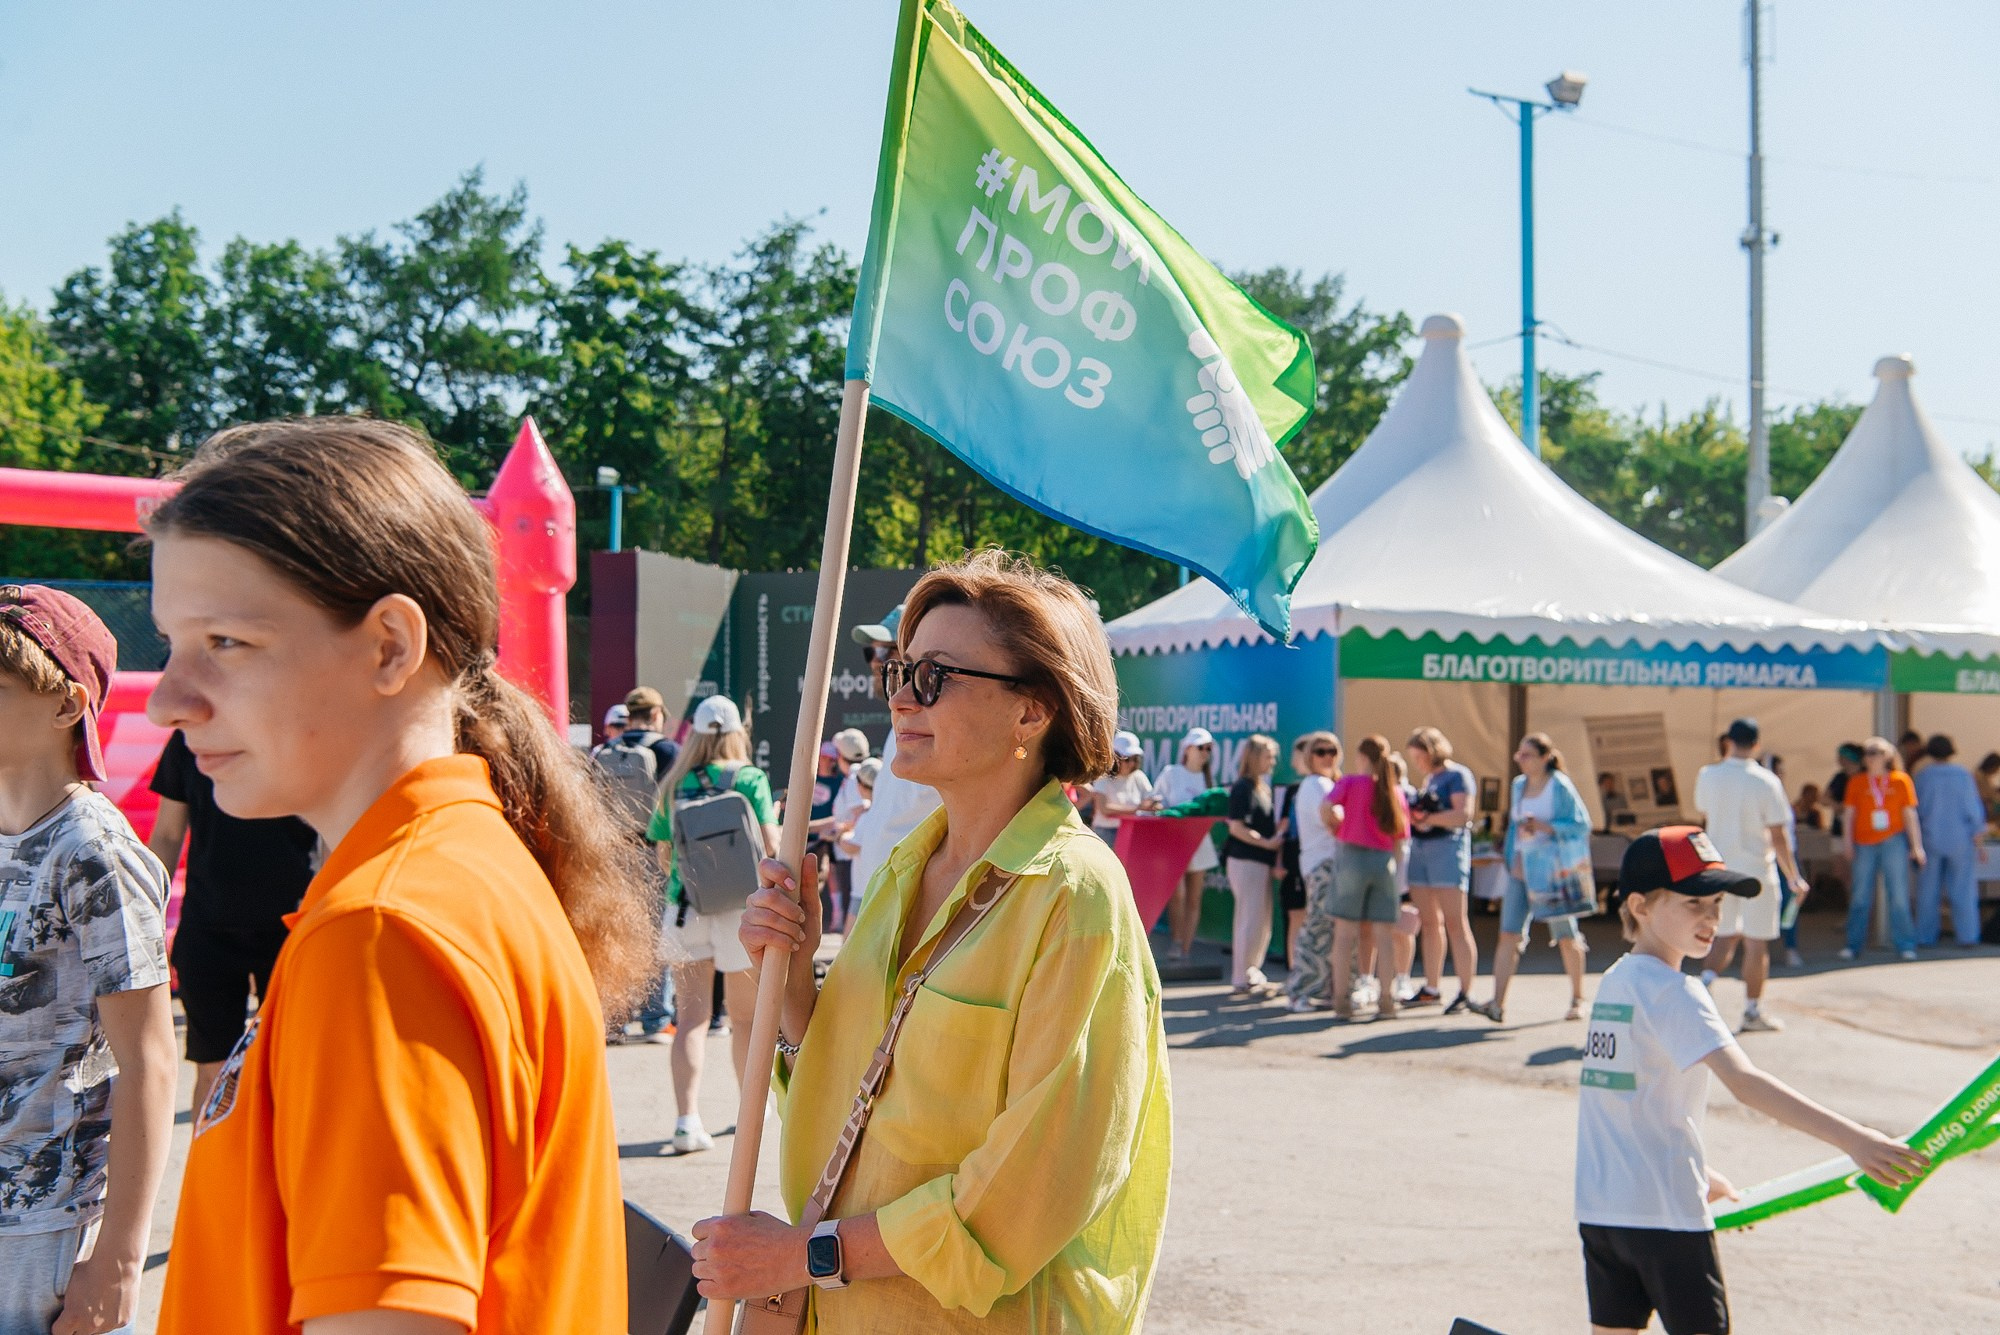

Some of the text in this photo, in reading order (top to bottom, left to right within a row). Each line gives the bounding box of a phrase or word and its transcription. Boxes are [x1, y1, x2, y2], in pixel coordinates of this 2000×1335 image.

[955, 205, 1137, 343] ПРОФ
[943, 277, 1113, 410] СОЮЗ
[1422, 653, 1818, 688] БЛАГОТВОРИТЕЛЬНАЯ ЯРМАРКА
